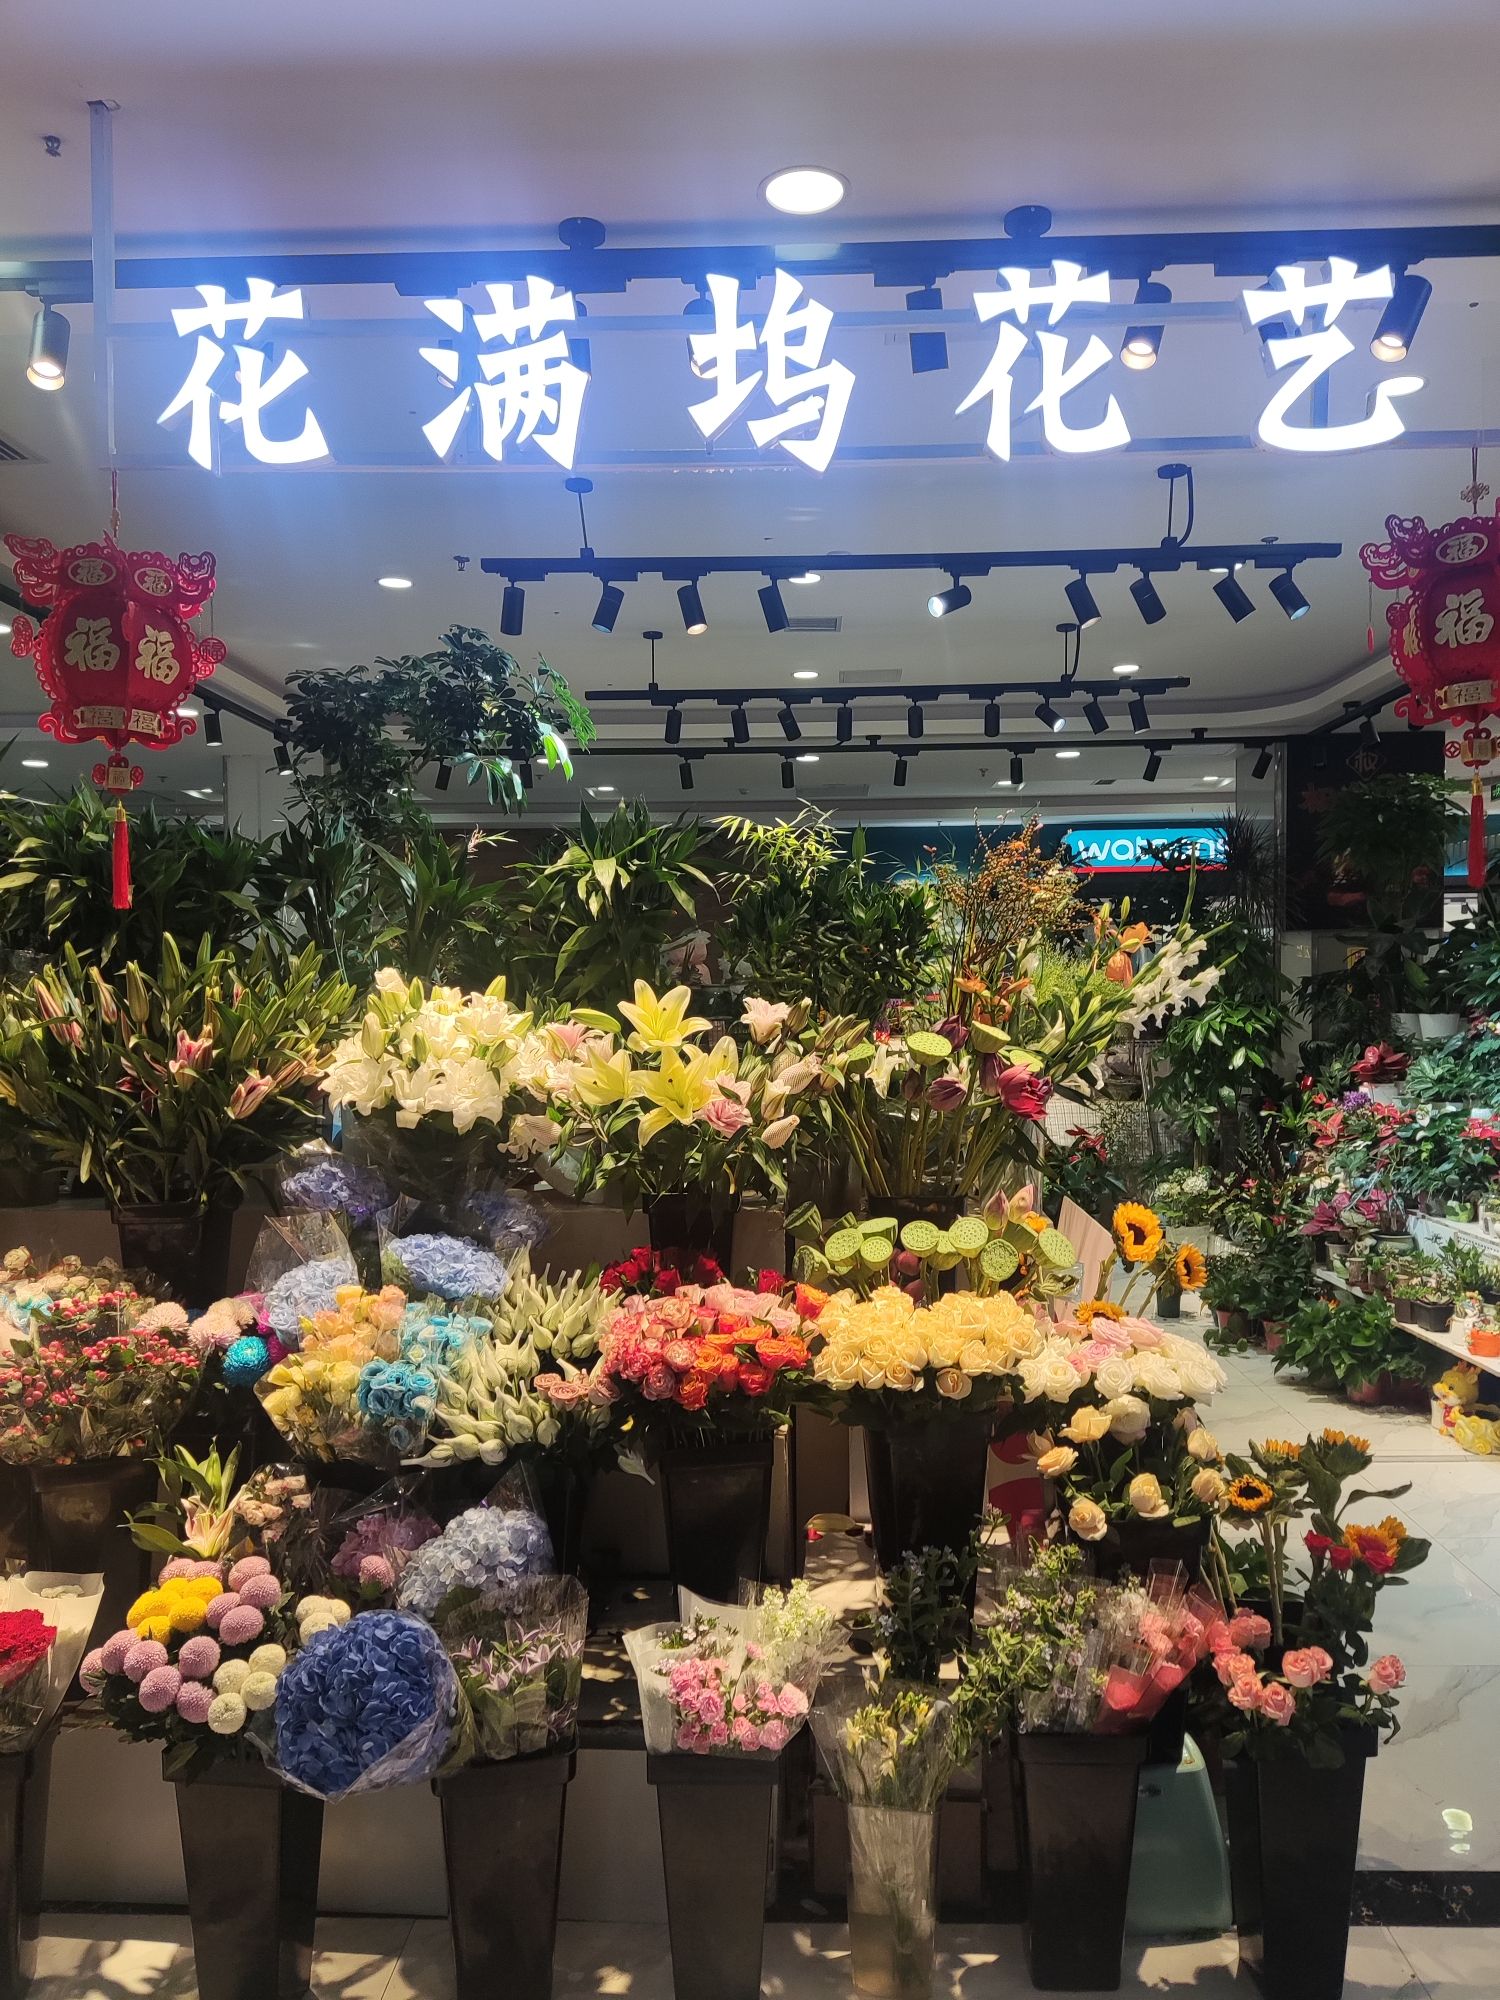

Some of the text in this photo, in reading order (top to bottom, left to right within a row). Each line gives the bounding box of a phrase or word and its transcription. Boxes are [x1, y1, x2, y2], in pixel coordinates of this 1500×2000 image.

[160, 257, 1424, 472] 花满坞花艺
[64, 616, 120, 673] 福
[1435, 588, 1494, 649] 福
[135, 625, 180, 685] 福
[132, 709, 159, 731] 福
